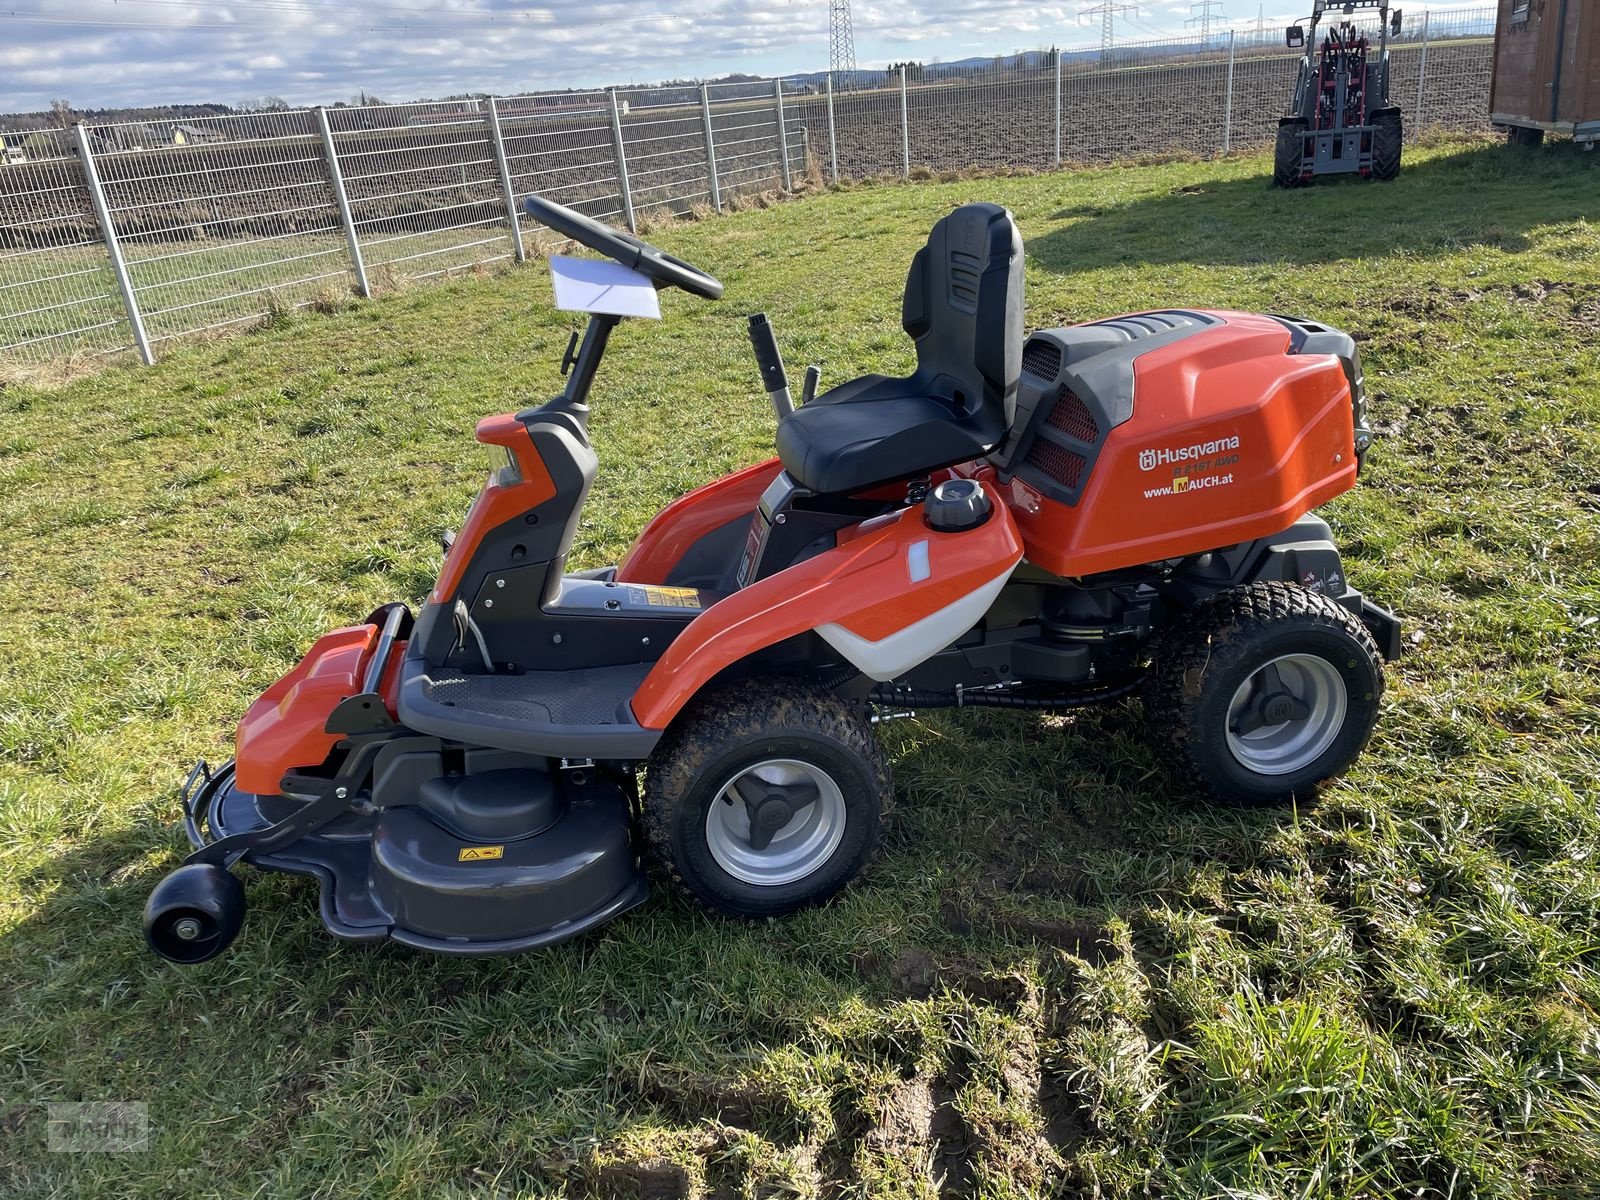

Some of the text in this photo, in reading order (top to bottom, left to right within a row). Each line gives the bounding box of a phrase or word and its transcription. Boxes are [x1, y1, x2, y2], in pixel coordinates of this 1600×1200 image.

[1158, 436, 1239, 465] Husqvarna
[1174, 455, 1239, 476] R 216T AWD
[1144, 473, 1233, 498] www.MAUCH.at
